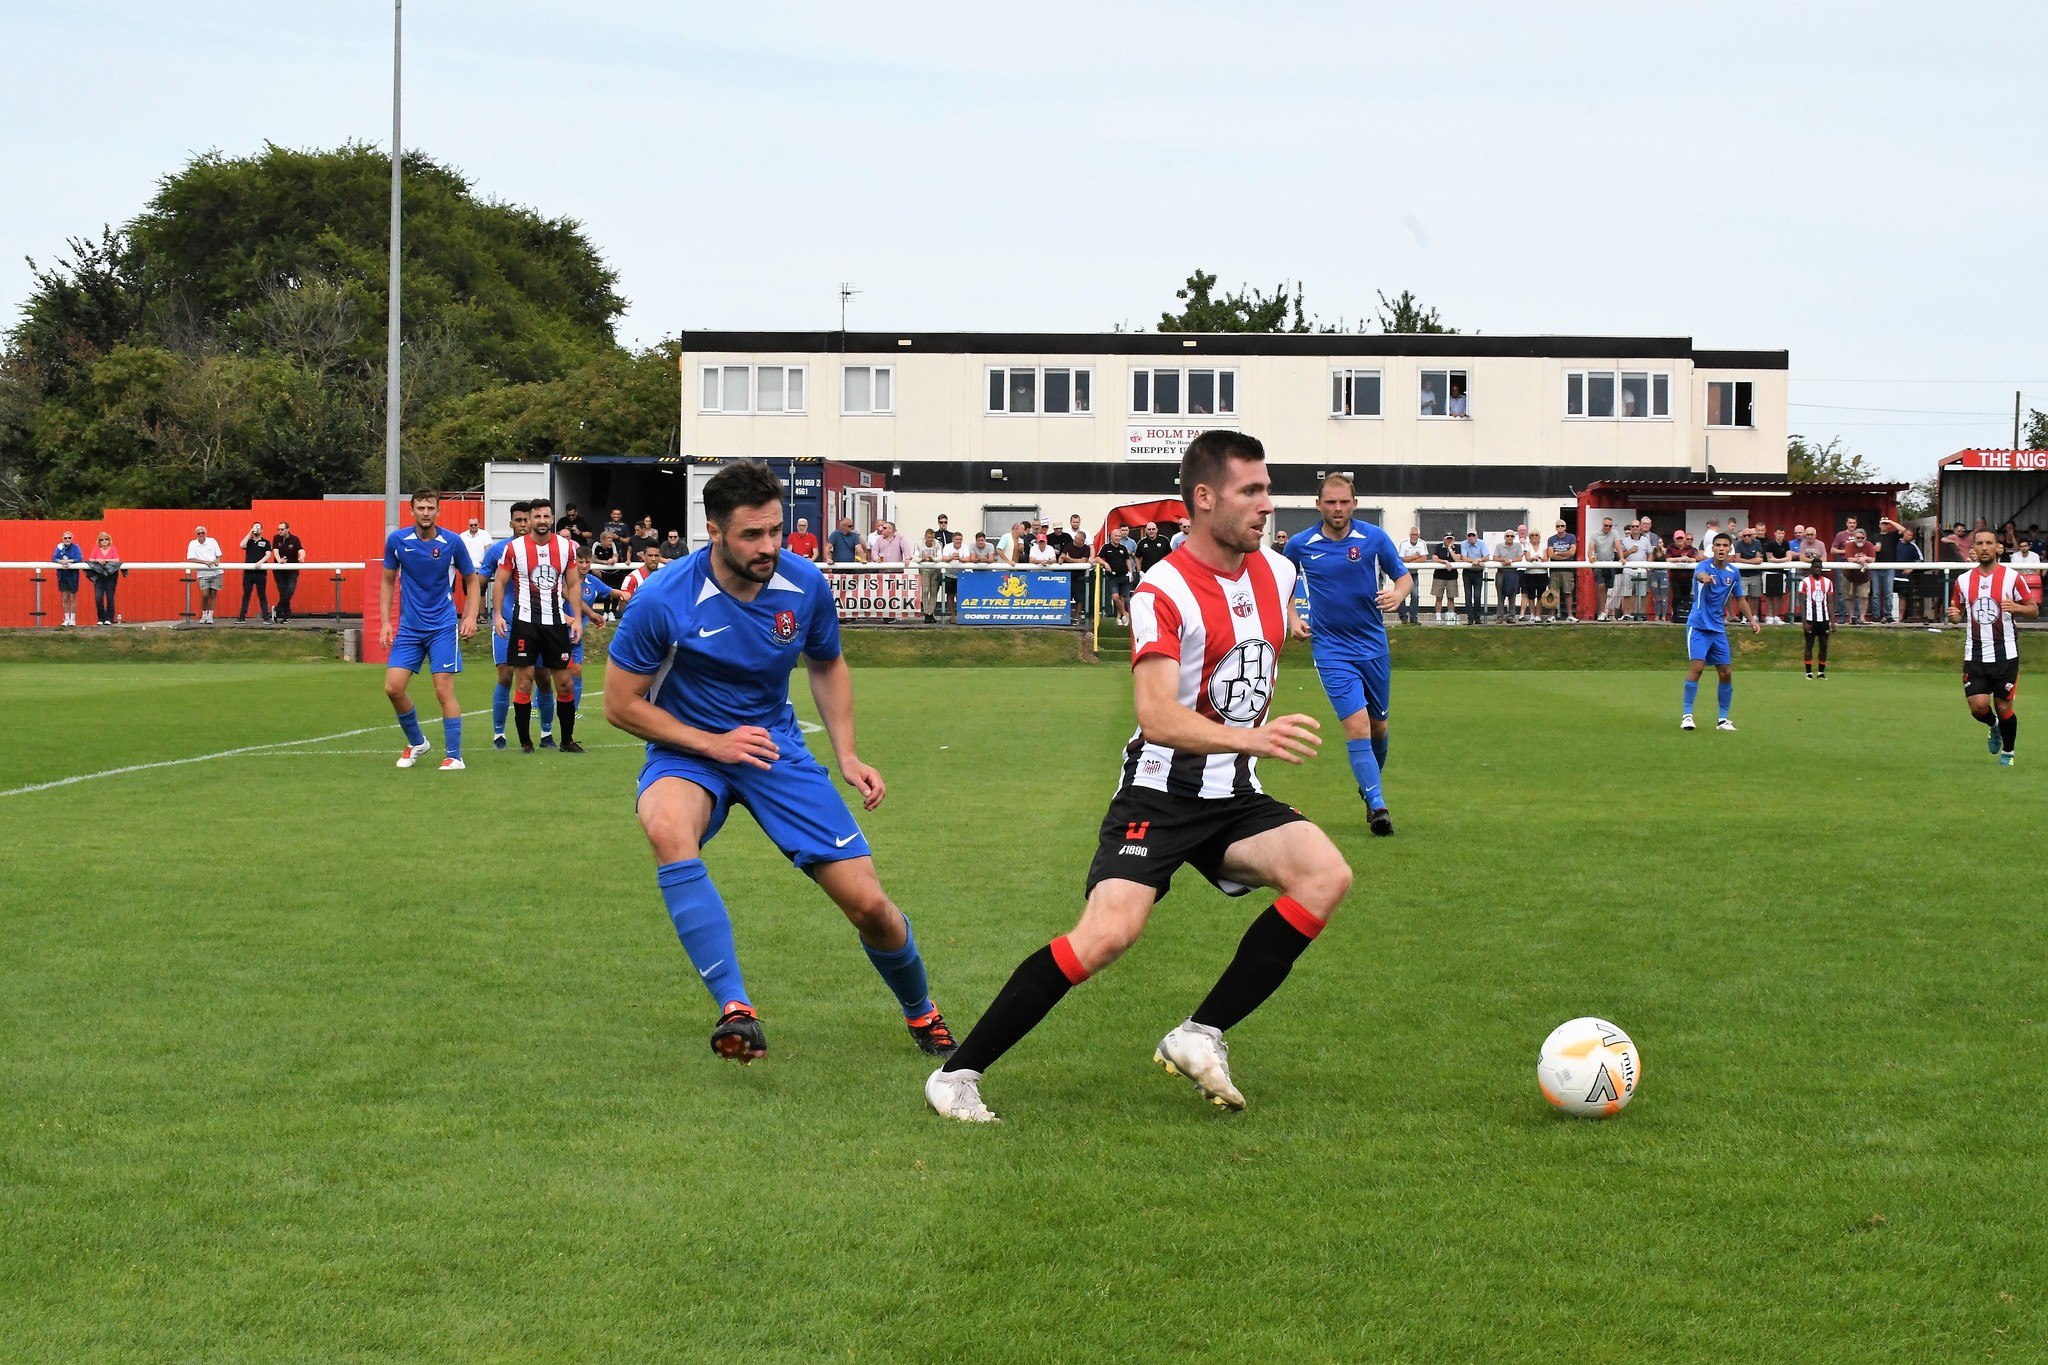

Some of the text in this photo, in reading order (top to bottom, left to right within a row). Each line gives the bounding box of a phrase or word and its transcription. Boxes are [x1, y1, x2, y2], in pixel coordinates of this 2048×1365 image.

[1147, 429, 1183, 438] HOLM
[1130, 446, 1176, 454] SHEPPEY
[1978, 452, 2048, 467] THE NIG
[827, 579, 917, 590] HIS IS THE
[835, 598, 915, 610] ADDOCK
[961, 598, 1067, 607] A2 TYRE SUPPLIES
[518, 639, 525, 651] 9
[1126, 845, 1148, 857] 1890
[1622, 1052, 1634, 1092] mitre
